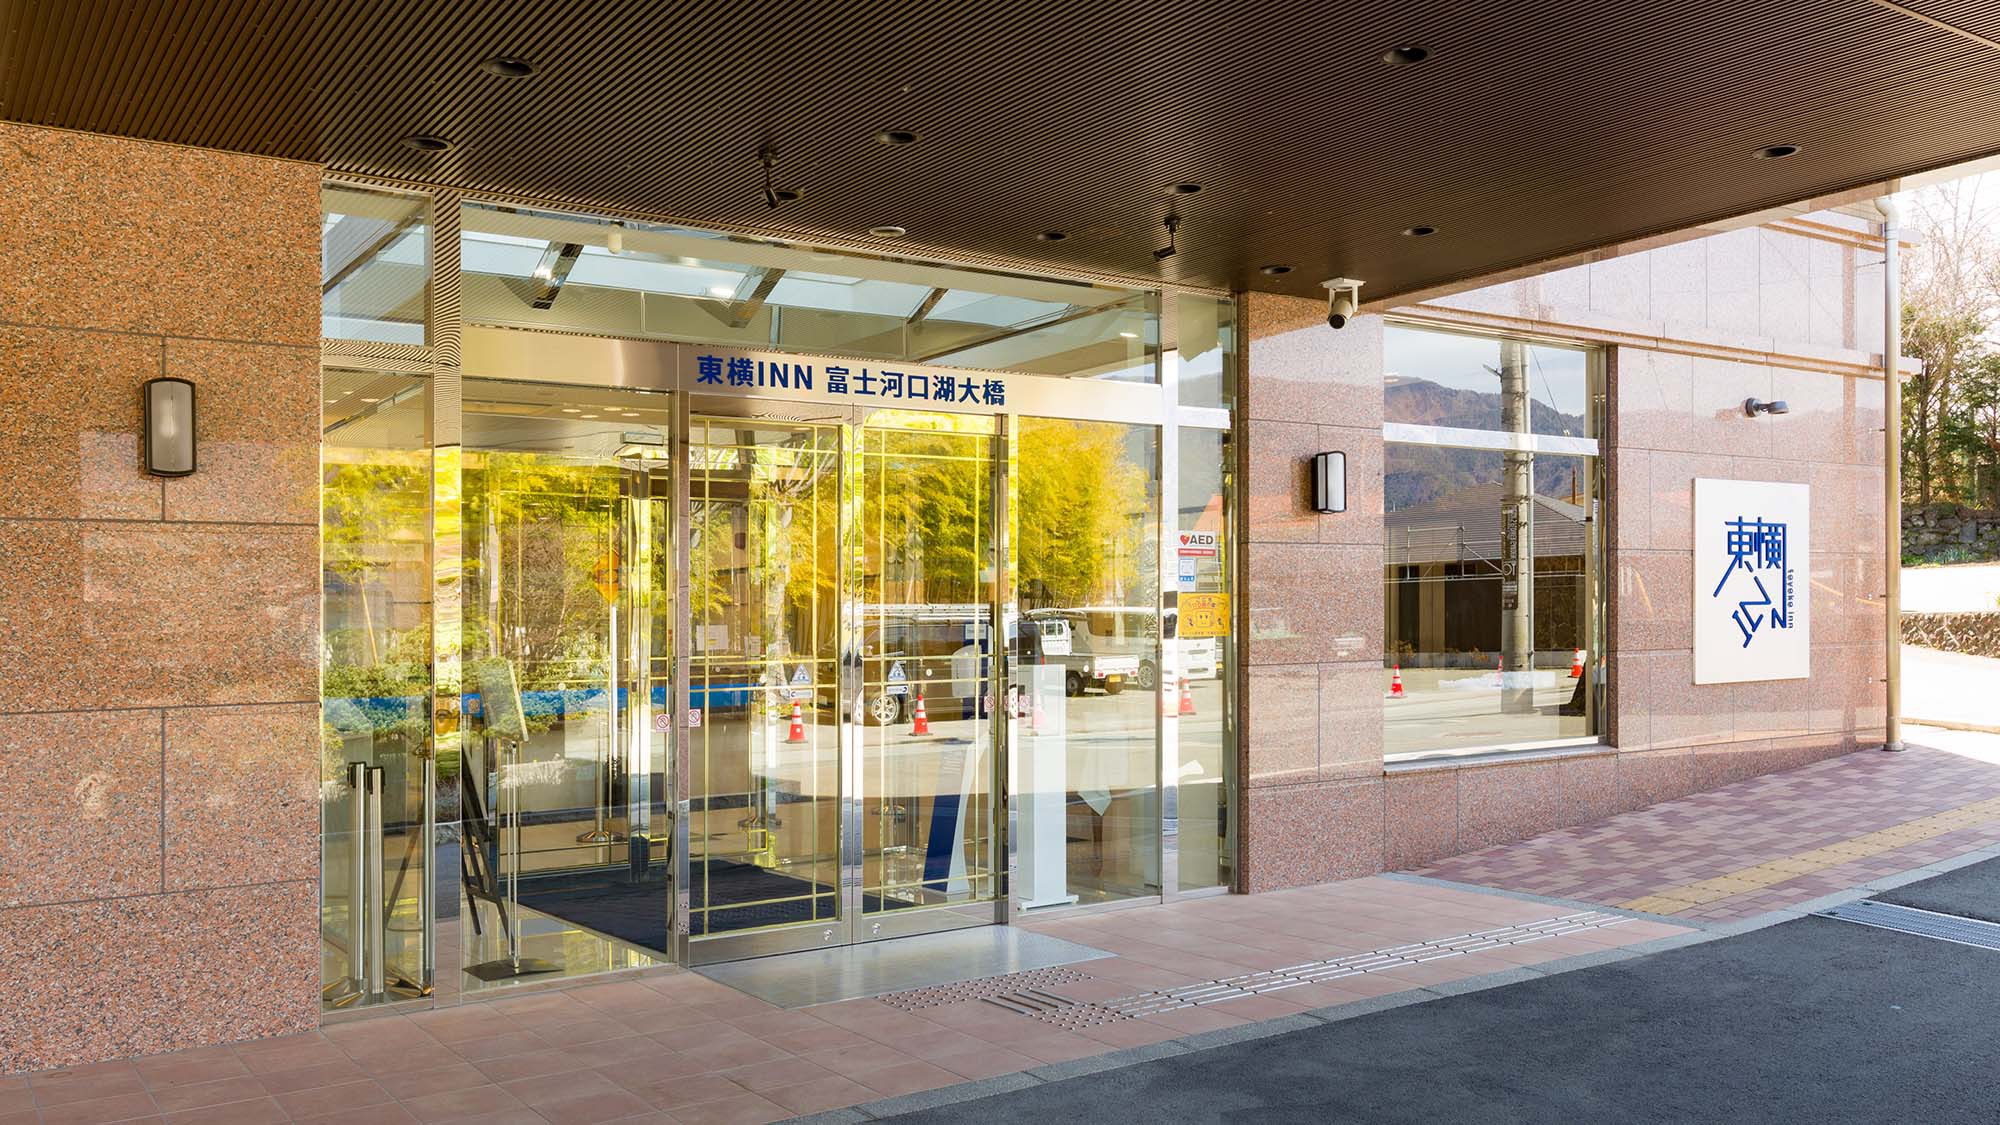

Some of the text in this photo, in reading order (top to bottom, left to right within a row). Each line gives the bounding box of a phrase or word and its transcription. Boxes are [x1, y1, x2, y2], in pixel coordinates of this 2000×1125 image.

[696, 354, 1005, 406] 東横INN 富士河口湖大橋
[1190, 534, 1214, 545] AED
[1787, 611, 1795, 629] inn
